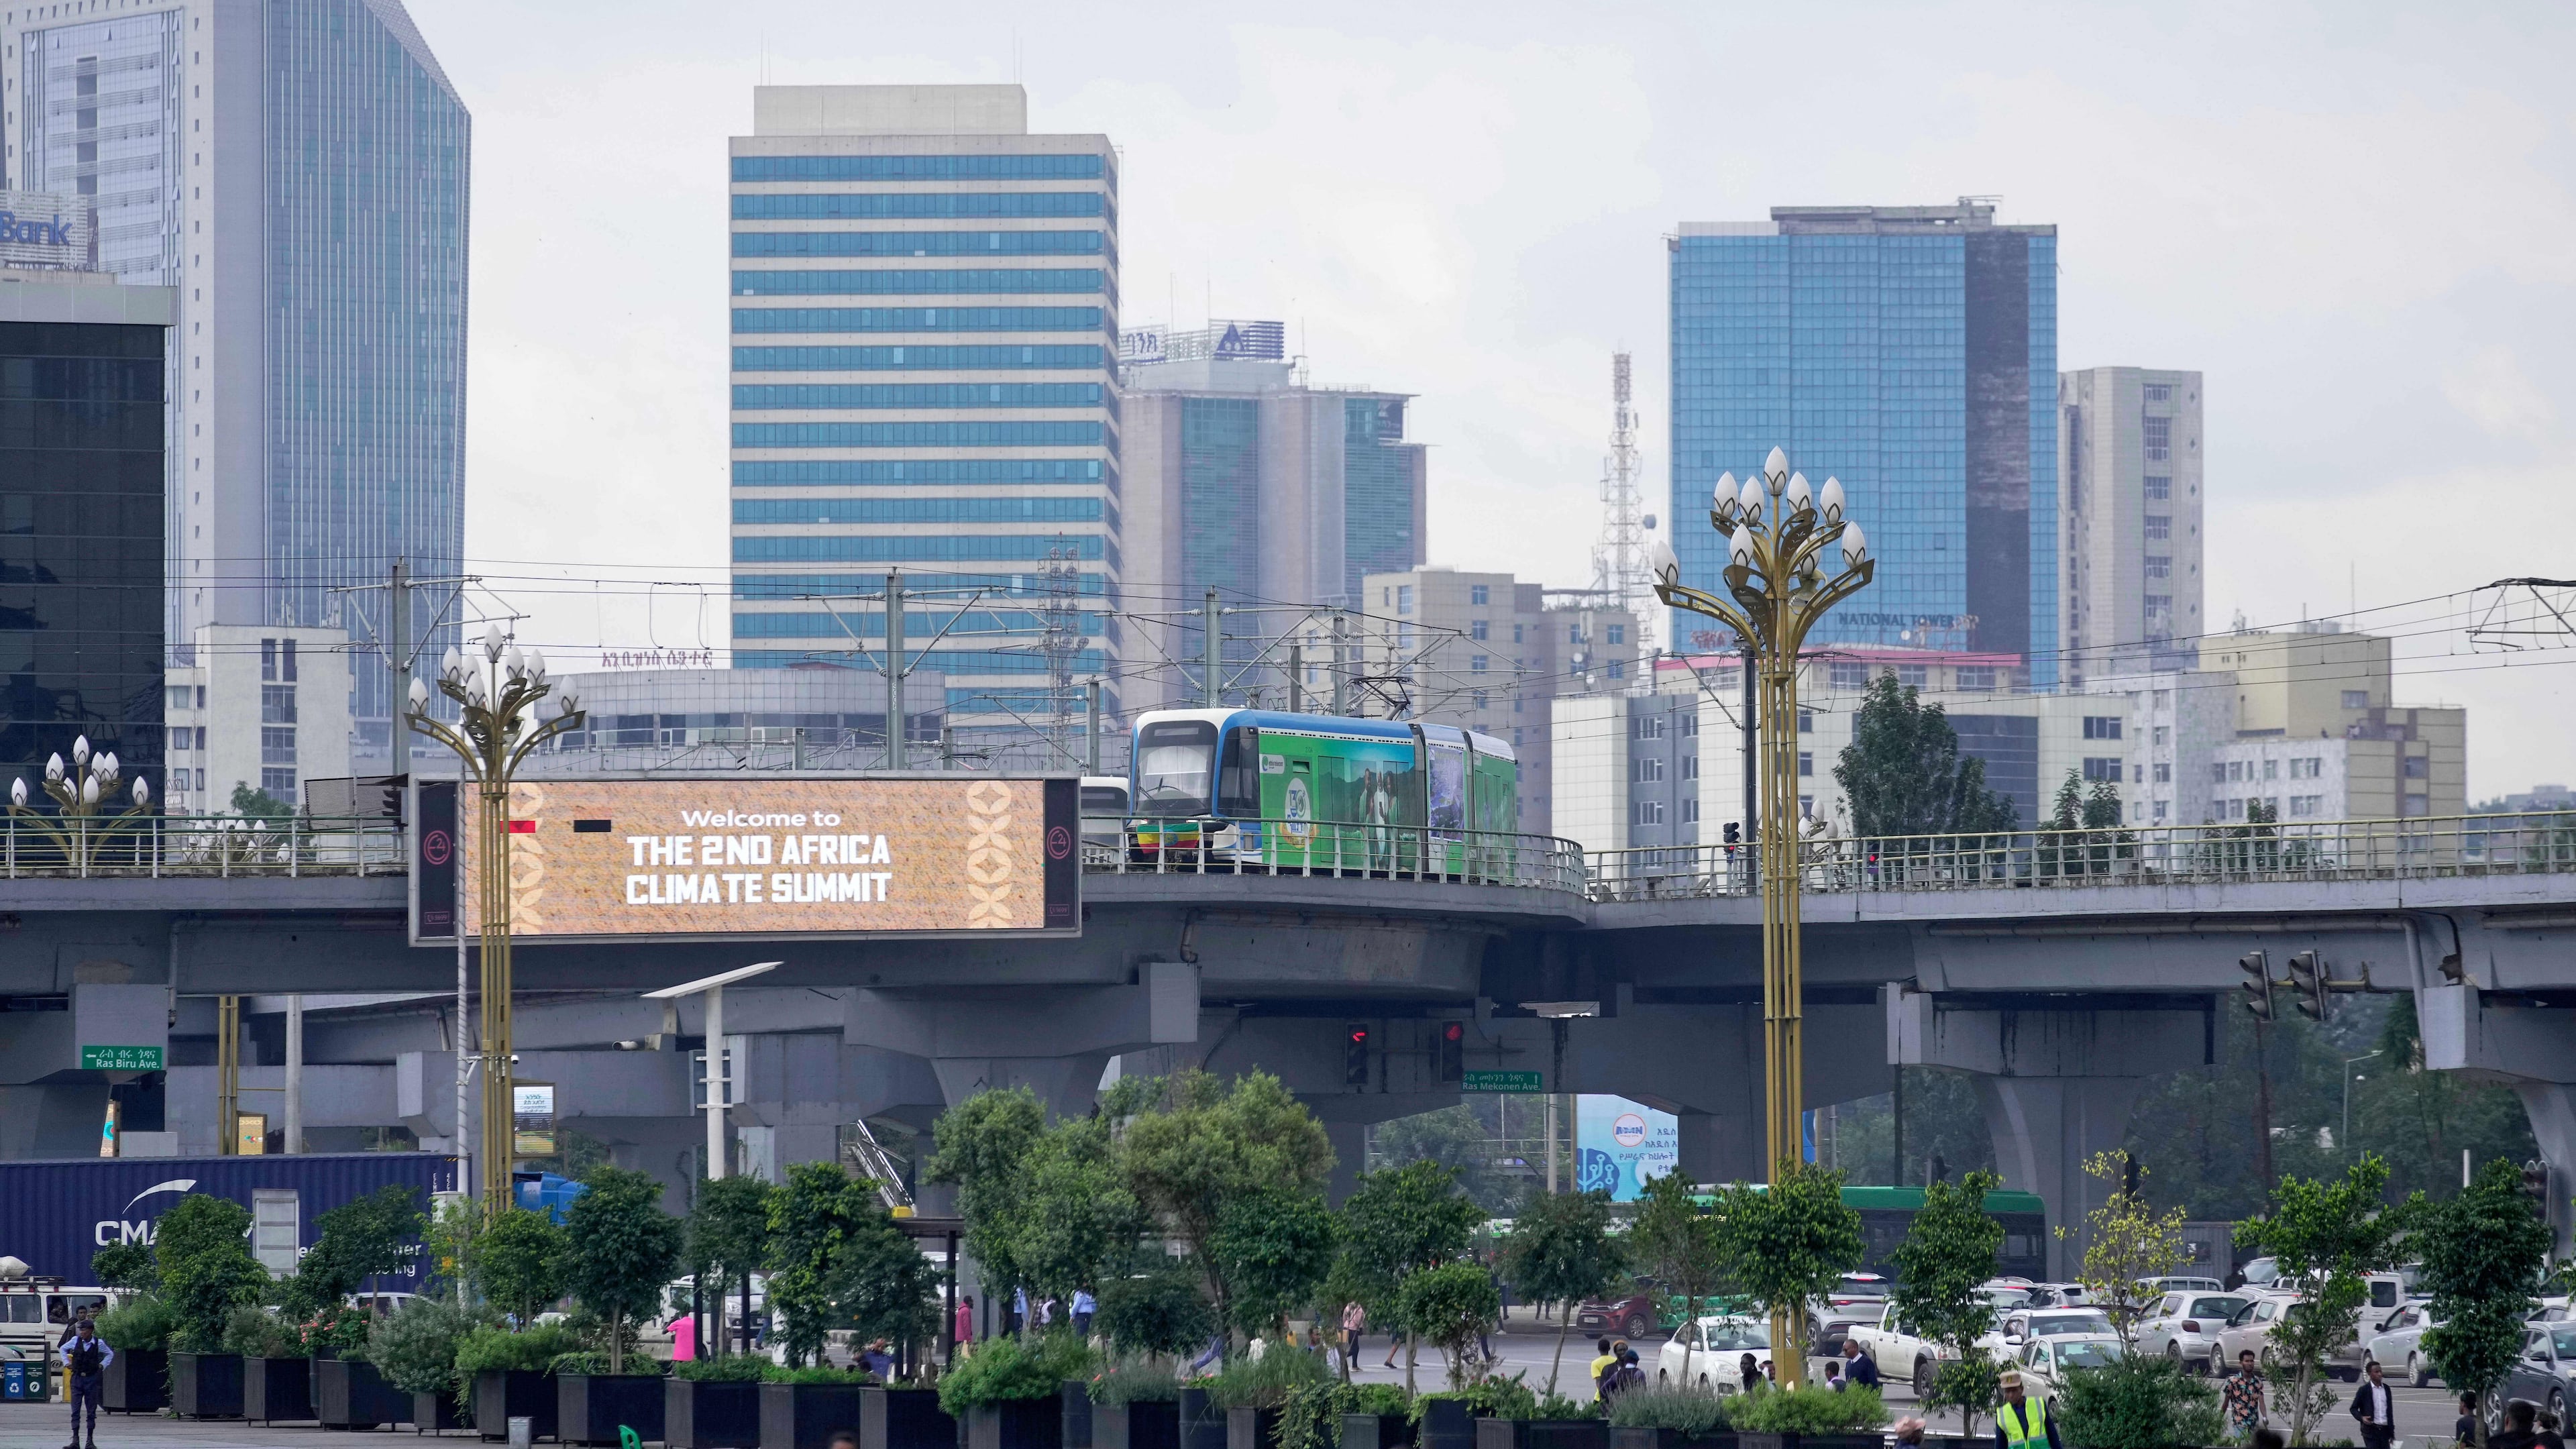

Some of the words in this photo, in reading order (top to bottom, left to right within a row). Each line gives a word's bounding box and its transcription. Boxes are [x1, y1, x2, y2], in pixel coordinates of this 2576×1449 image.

[0, 211, 72, 246] Bank
[1838, 612, 1906, 626] NATIONAL
[1912, 614, 1954, 627] TOWER
[681, 809, 806, 827] Welcome
[812, 810, 841, 827] to
[627, 835, 693, 866] THE
[701, 835, 771, 865] 2ND
[781, 834, 891, 865] AFRICA
[626, 873, 763, 904] CLIMATE
[771, 872, 892, 903] SUMMIT
[99, 1049, 113, 1058] ራስ
[118, 1049, 133, 1059] ብሩ
[138, 1049, 156, 1059] ጎዳና
[96, 1059, 113, 1068] Ras
[116, 1059, 136, 1068] Biru
[138, 1059, 160, 1069] Ave.
[1462, 1082, 1478, 1090] Ras
[1480, 1082, 1520, 1090] Mekonen
[1521, 1083, 1541, 1091] Ave.
